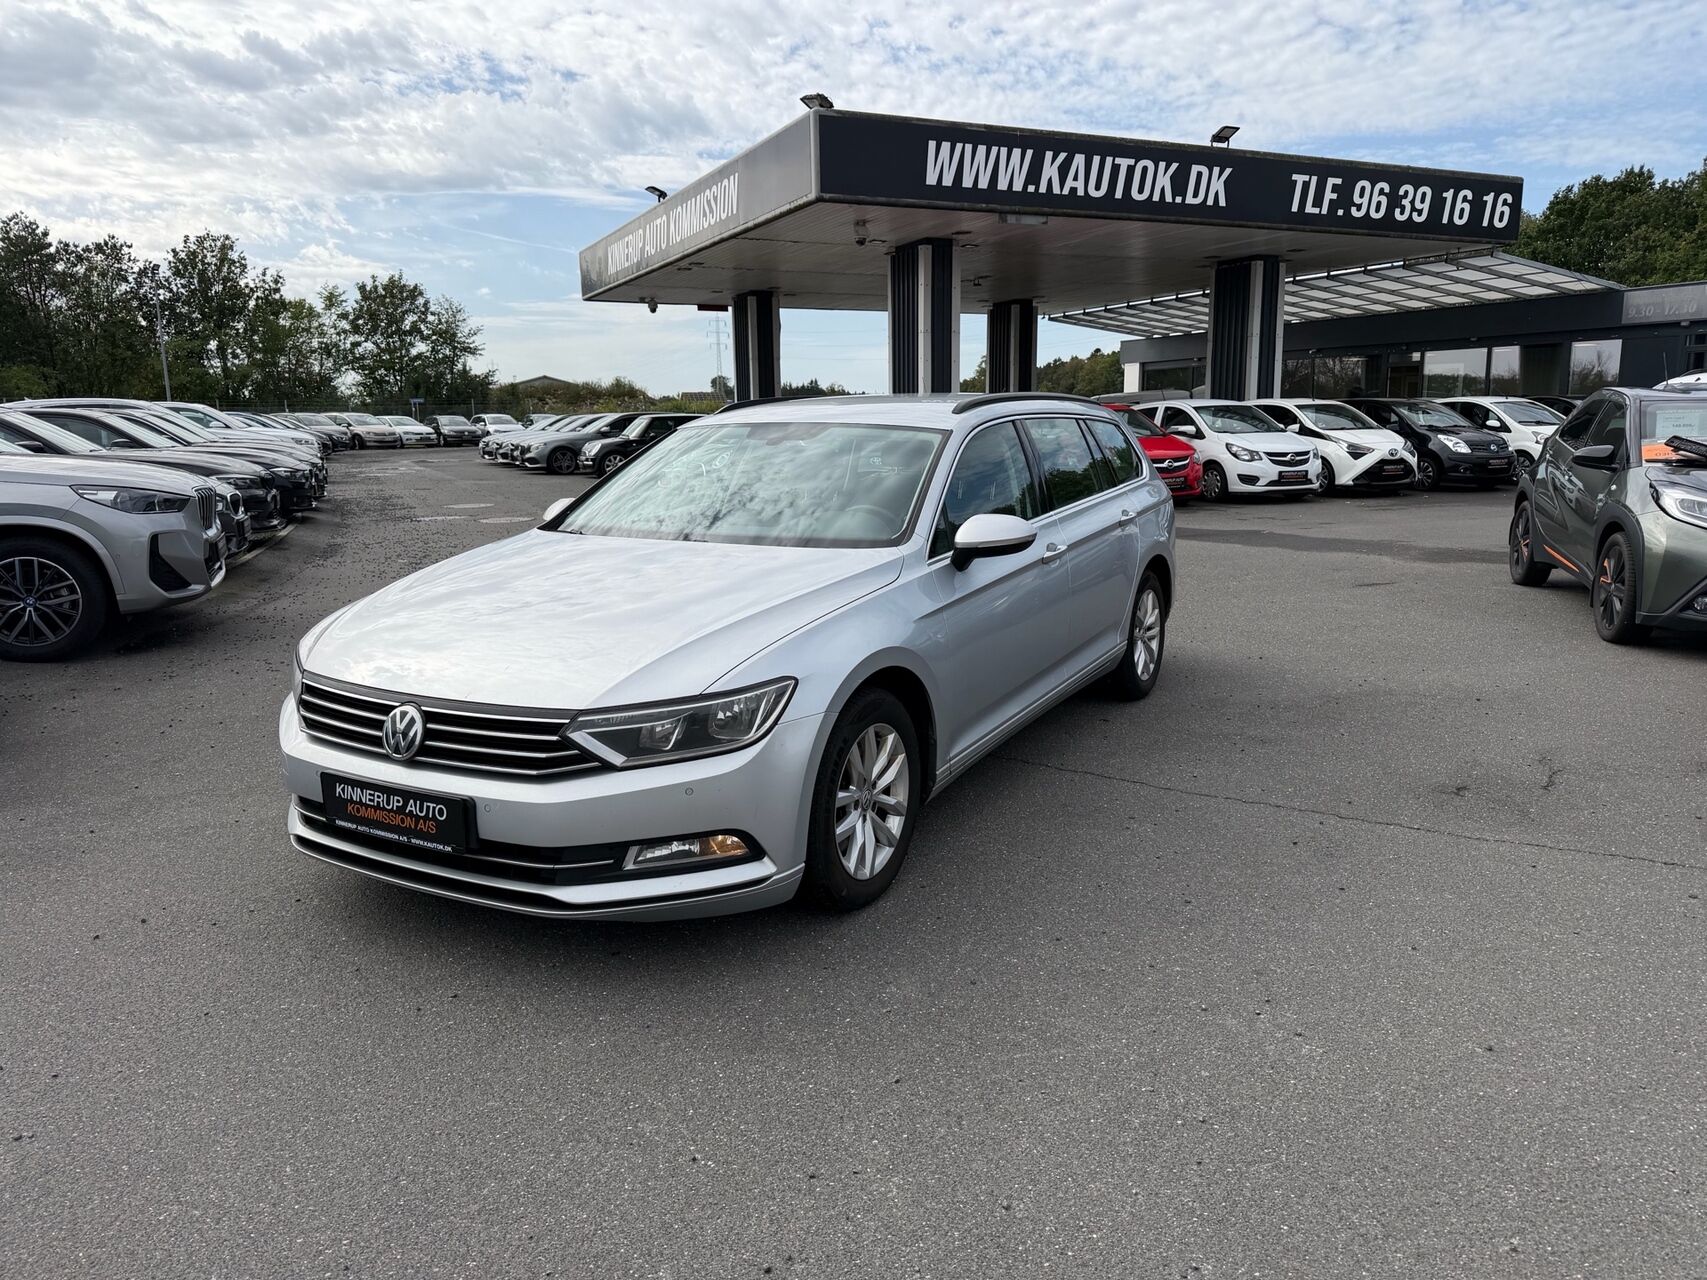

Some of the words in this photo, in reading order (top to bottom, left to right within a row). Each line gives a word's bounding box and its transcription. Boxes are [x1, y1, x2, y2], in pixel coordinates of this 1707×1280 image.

[925, 140, 1233, 207] WWW.KAUTOK.DK
[607, 229, 643, 275] KINNERUP
[644, 214, 667, 258] AUTO
[669, 172, 739, 246] KOMMISSION
[1291, 174, 1344, 216] TLF.
[1351, 180, 1390, 220] 96
[1394, 184, 1432, 223] 39
[1441, 188, 1473, 226] 16
[1482, 192, 1513, 229] 16
[336, 783, 403, 810] KINNERUP
[405, 799, 447, 821] AUTO
[347, 802, 416, 828] KOMMISSION
[418, 819, 437, 834] A/S
